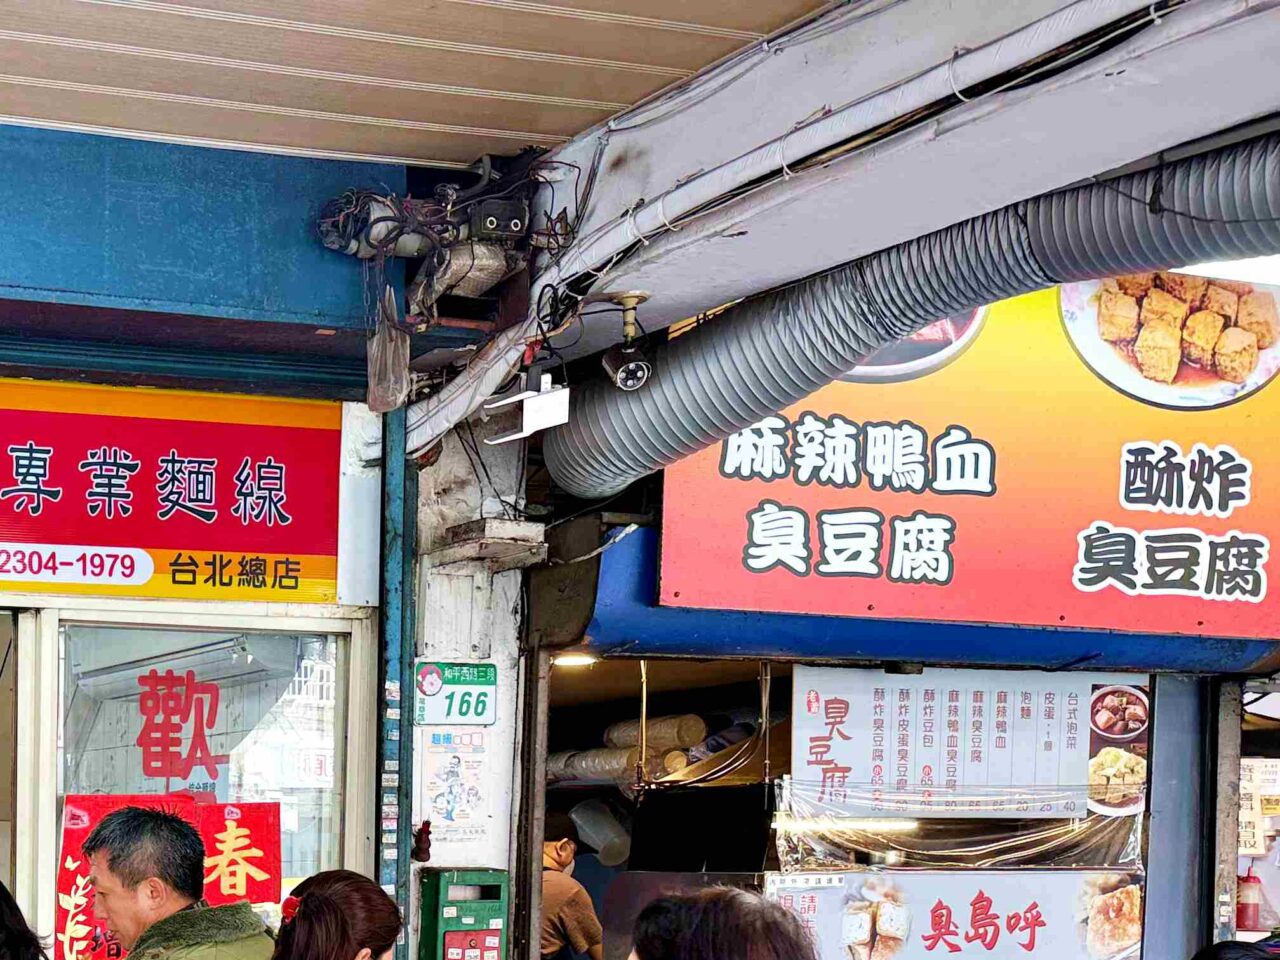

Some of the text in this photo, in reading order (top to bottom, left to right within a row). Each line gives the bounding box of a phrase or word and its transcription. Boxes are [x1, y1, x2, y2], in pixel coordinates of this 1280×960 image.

[721, 411, 996, 495] 麻辣鴨血
[1123, 445, 1249, 513] 酥炸
[168, 552, 302, 591] 台北總店
[744, 501, 955, 584] 臭豆腐
[1076, 525, 1266, 598] 臭豆腐
[444, 666, 495, 681] 和平西路三段
[444, 691, 489, 719] 166
[136, 668, 219, 781] 歡
[806, 697, 853, 803] 臭豆腐
[203, 819, 271, 897] 春
